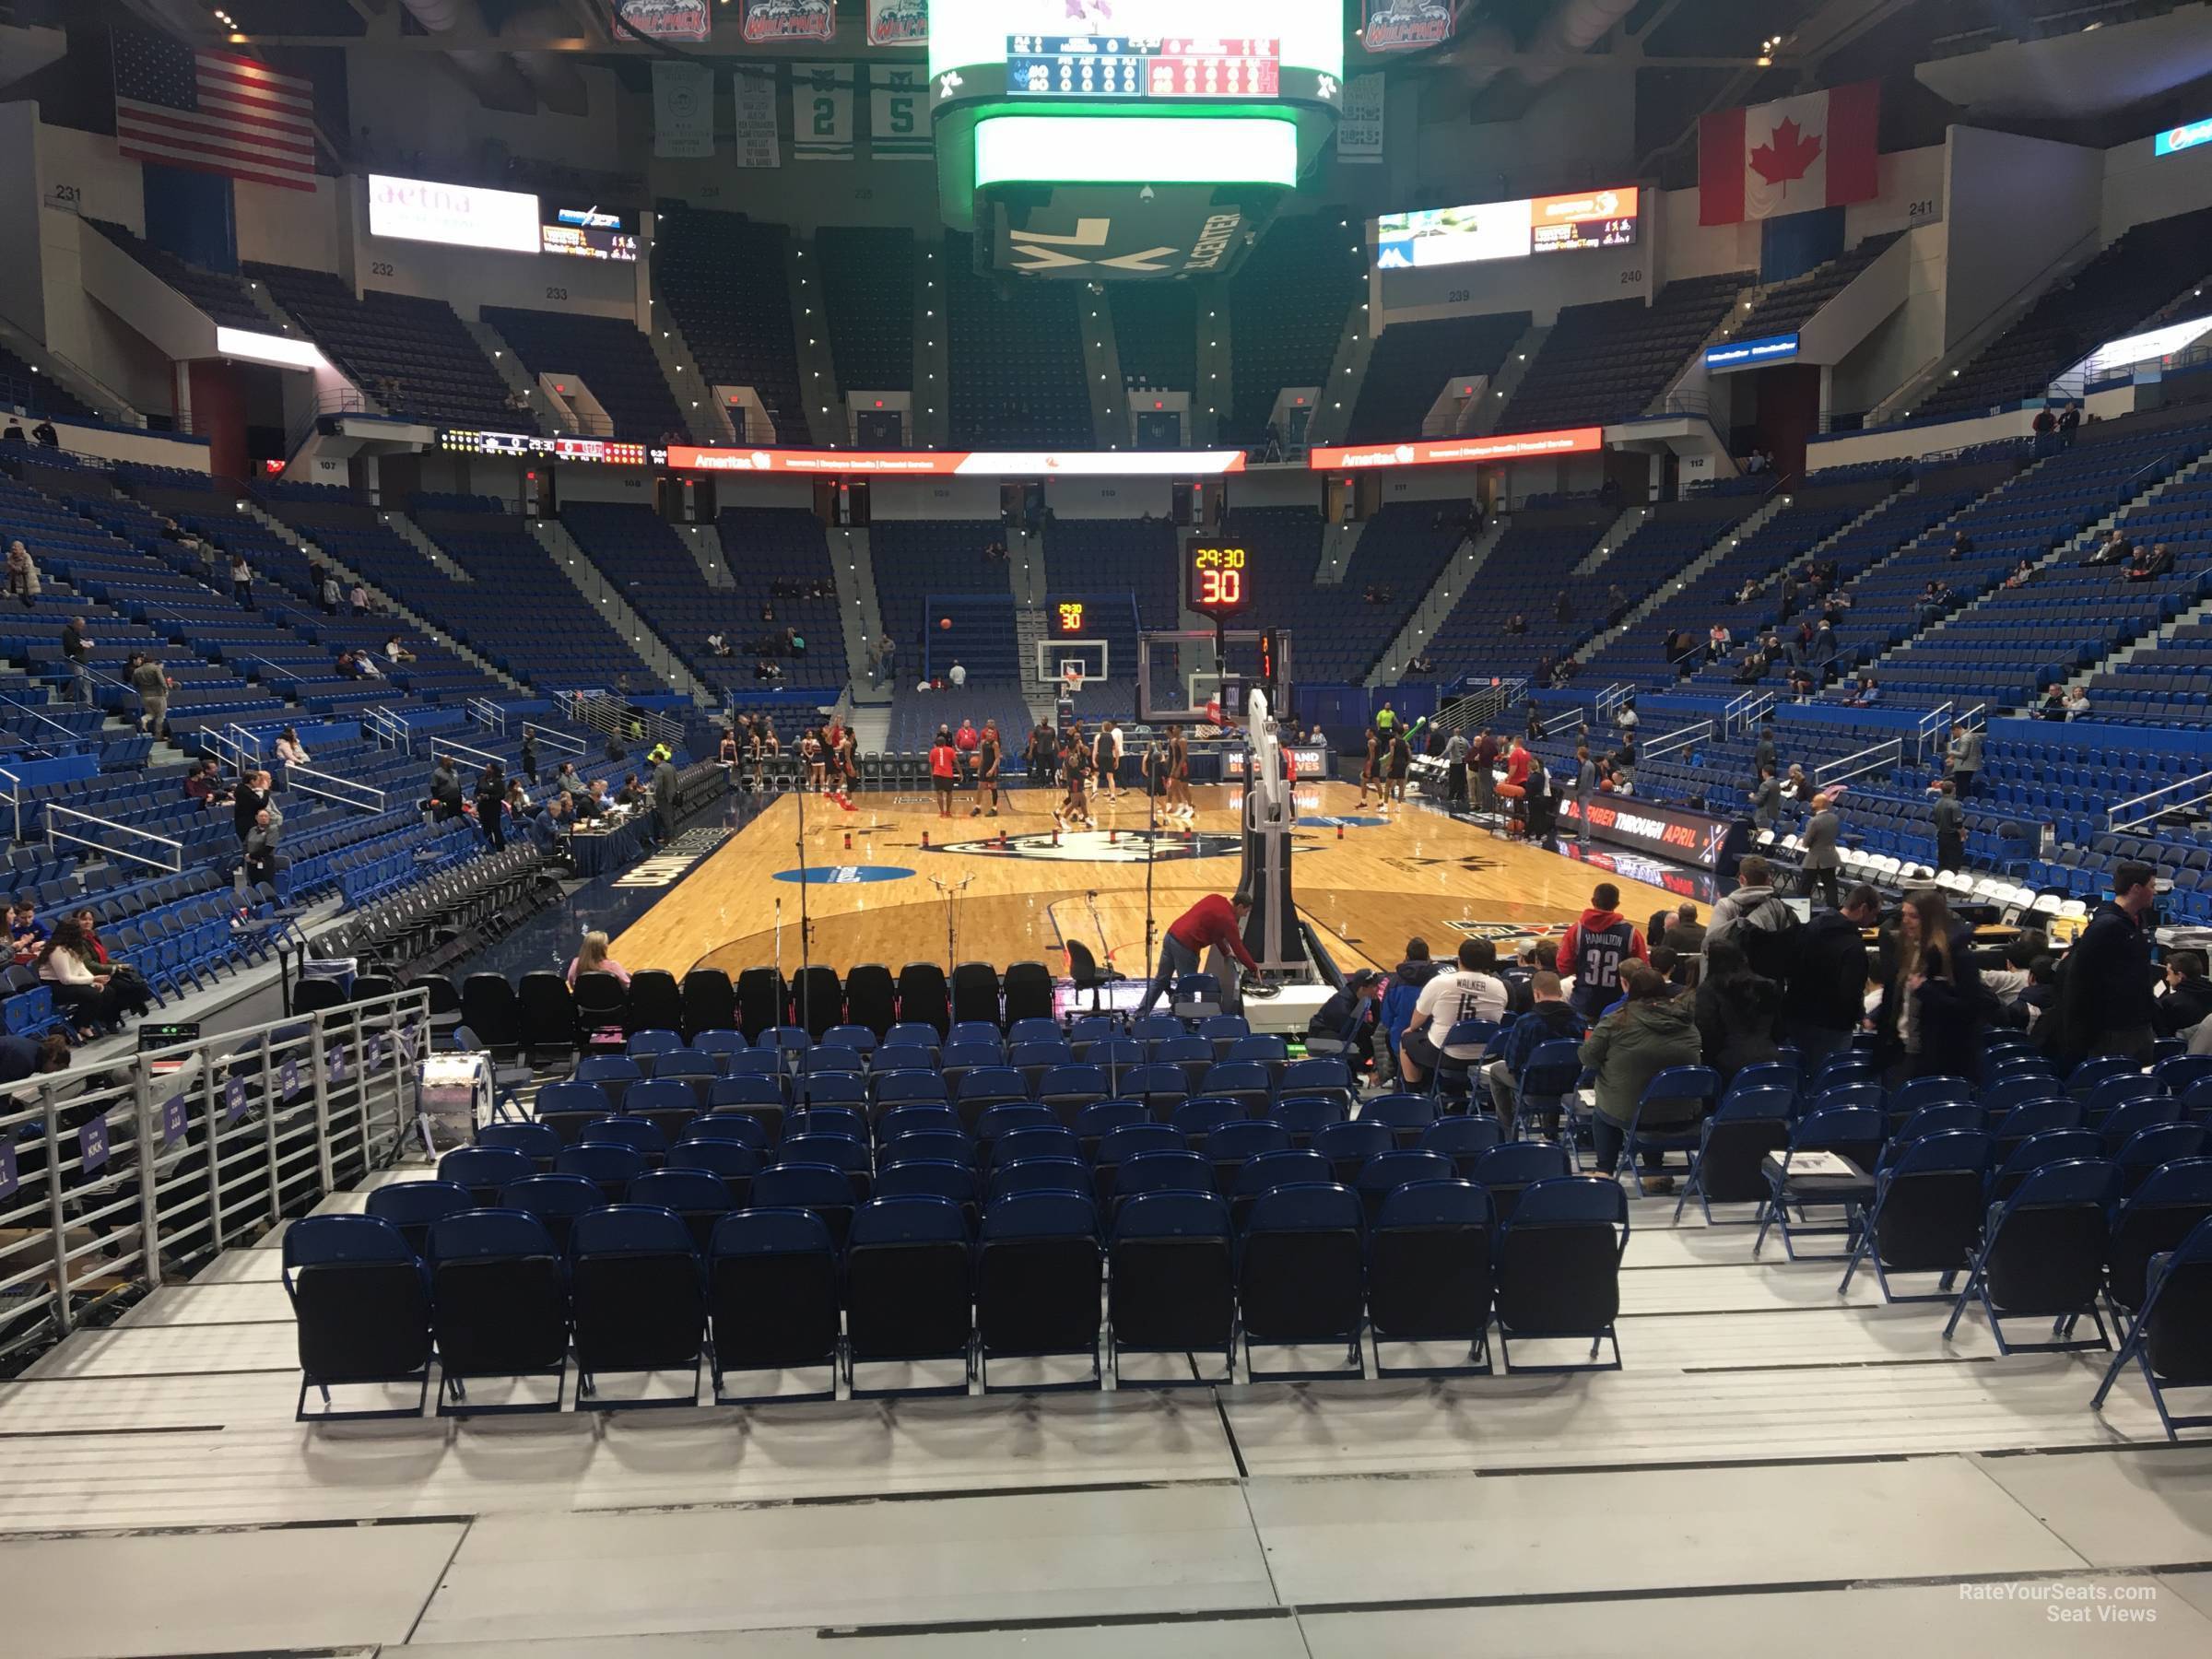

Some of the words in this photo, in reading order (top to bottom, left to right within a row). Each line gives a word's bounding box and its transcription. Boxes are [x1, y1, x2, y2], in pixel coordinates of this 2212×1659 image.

[813, 98, 834, 135] 2
[890, 98, 913, 133] 5
[55, 184, 81, 202] 231
[378, 184, 470, 213] aetna
[1910, 199, 1933, 216] 241
[371, 262, 394, 276] 232
[1621, 270, 1641, 284] 240
[546, 287, 568, 300] 233
[1449, 290, 1469, 302] 239
[320, 462, 336, 470] 107
[695, 453, 753, 468] Ameritas
[1690, 459, 1704, 467] 112
[1196, 549, 1244, 568] 29:30
[1204, 571, 1239, 603] 30
[1060, 604, 1082, 613] 29:30
[1063, 614, 1079, 629] 30
[1568, 801, 1616, 827] DEEMBER
[1615, 813, 1665, 840] THROUGH
[1663, 825, 1697, 848] APRIL
[610, 855, 700, 888] UCONN
[1585, 934, 1623, 947] HAMILTON
[1584, 948, 1619, 987] 32
[1457, 979, 1487, 992] WALKER
[1457, 994, 1477, 1020] 15
[171, 1115, 181, 1129] JJJ
[88, 1139, 103, 1158] KKK
